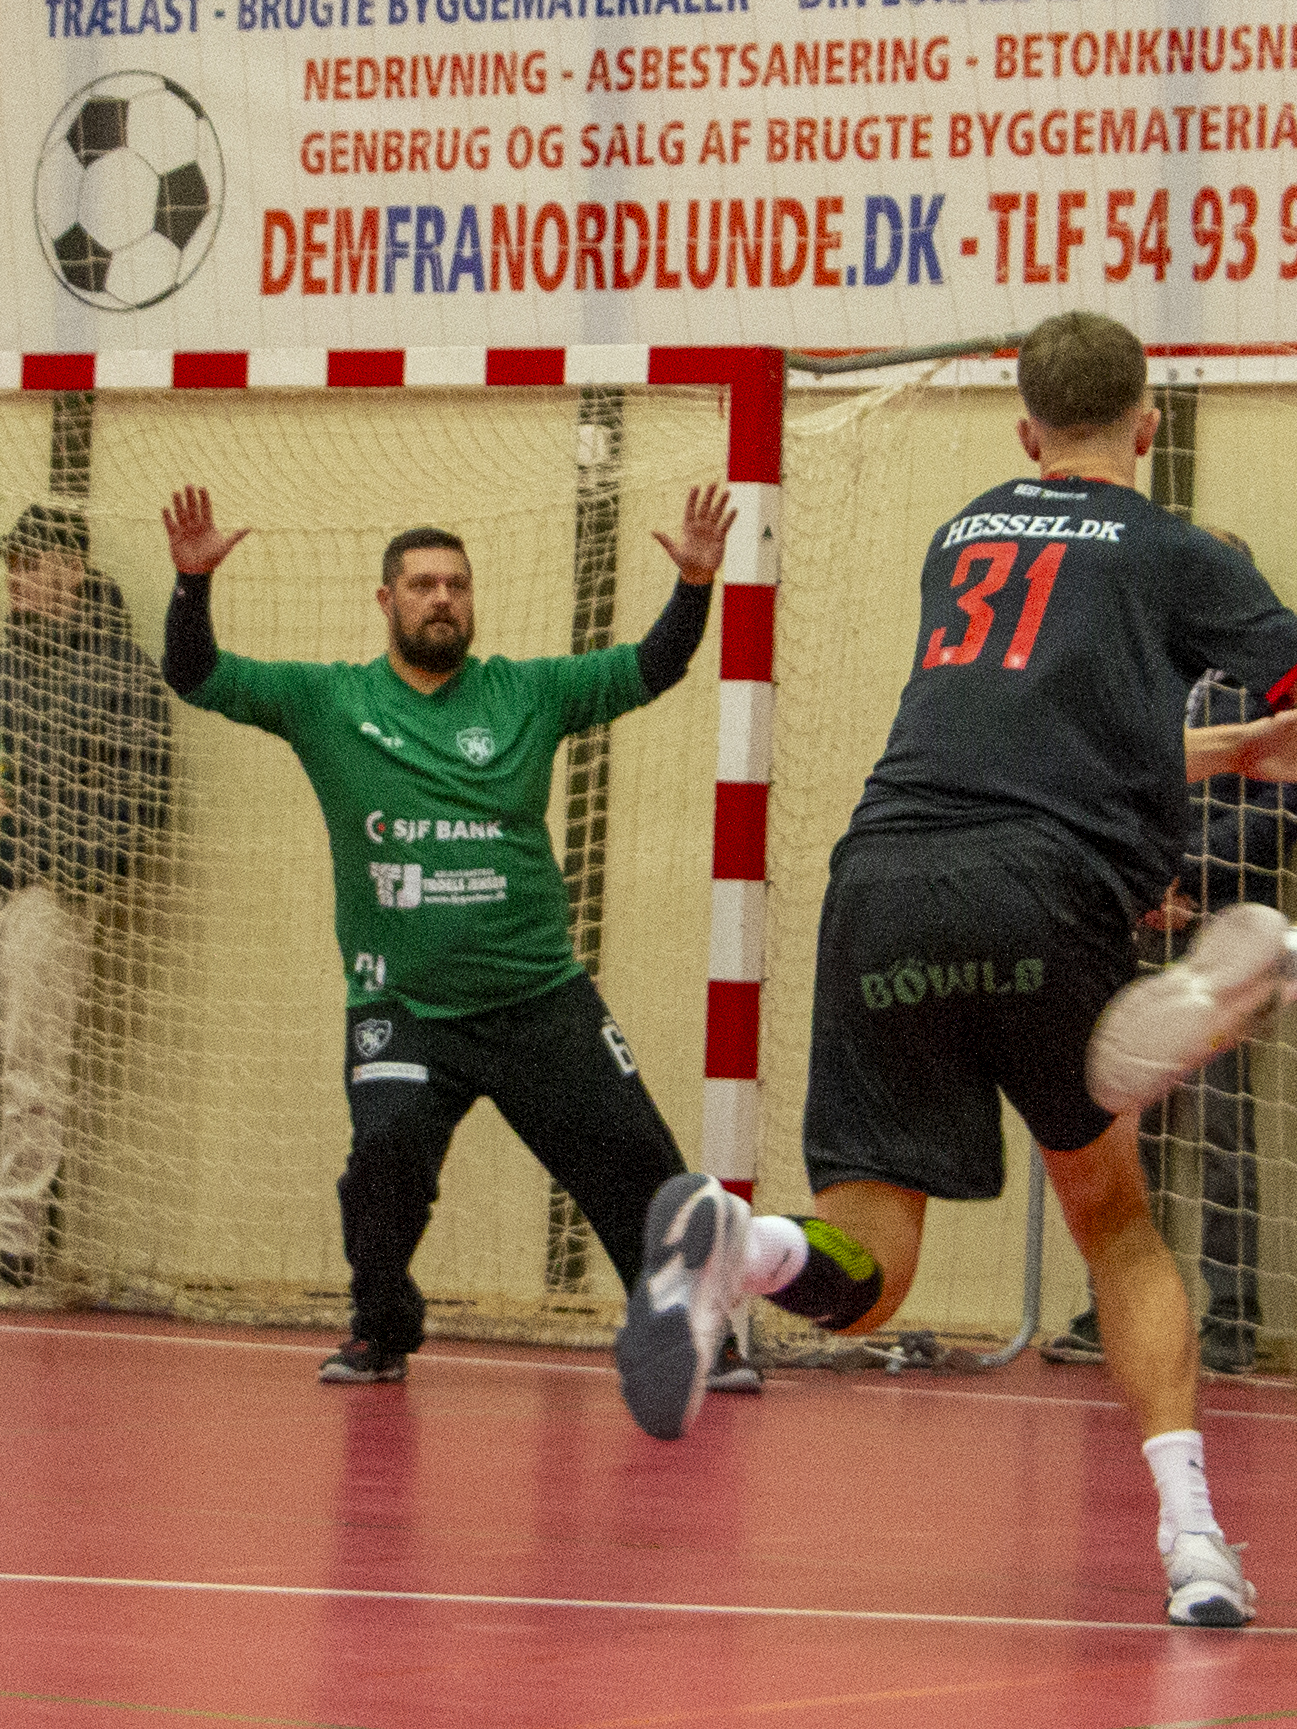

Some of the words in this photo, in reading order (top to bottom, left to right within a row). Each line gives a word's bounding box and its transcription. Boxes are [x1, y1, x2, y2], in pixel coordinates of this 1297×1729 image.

[45, 0, 199, 38] TRÆLAST
[237, 0, 374, 31] BRUGTE
[303, 50, 548, 102] NEDRIVNING
[586, 36, 951, 92] ASBESTSANERING
[300, 126, 491, 176] GENBRUG
[505, 124, 565, 170] OG
[580, 120, 686, 169] SALG
[699, 119, 752, 165] AF
[766, 115, 933, 163] BRUGTE
[259, 193, 946, 297] DEMFRANORDLUNDE.DK
[987, 190, 1087, 285] TLF
[1104, 189, 1173, 283] 54
[1190, 185, 1259, 283] 93
[940, 512, 1127, 550] HESSEL.DK
[921, 541, 1069, 671] 31
[393, 817, 433, 844] SJF
[435, 818, 503, 842] BANK
